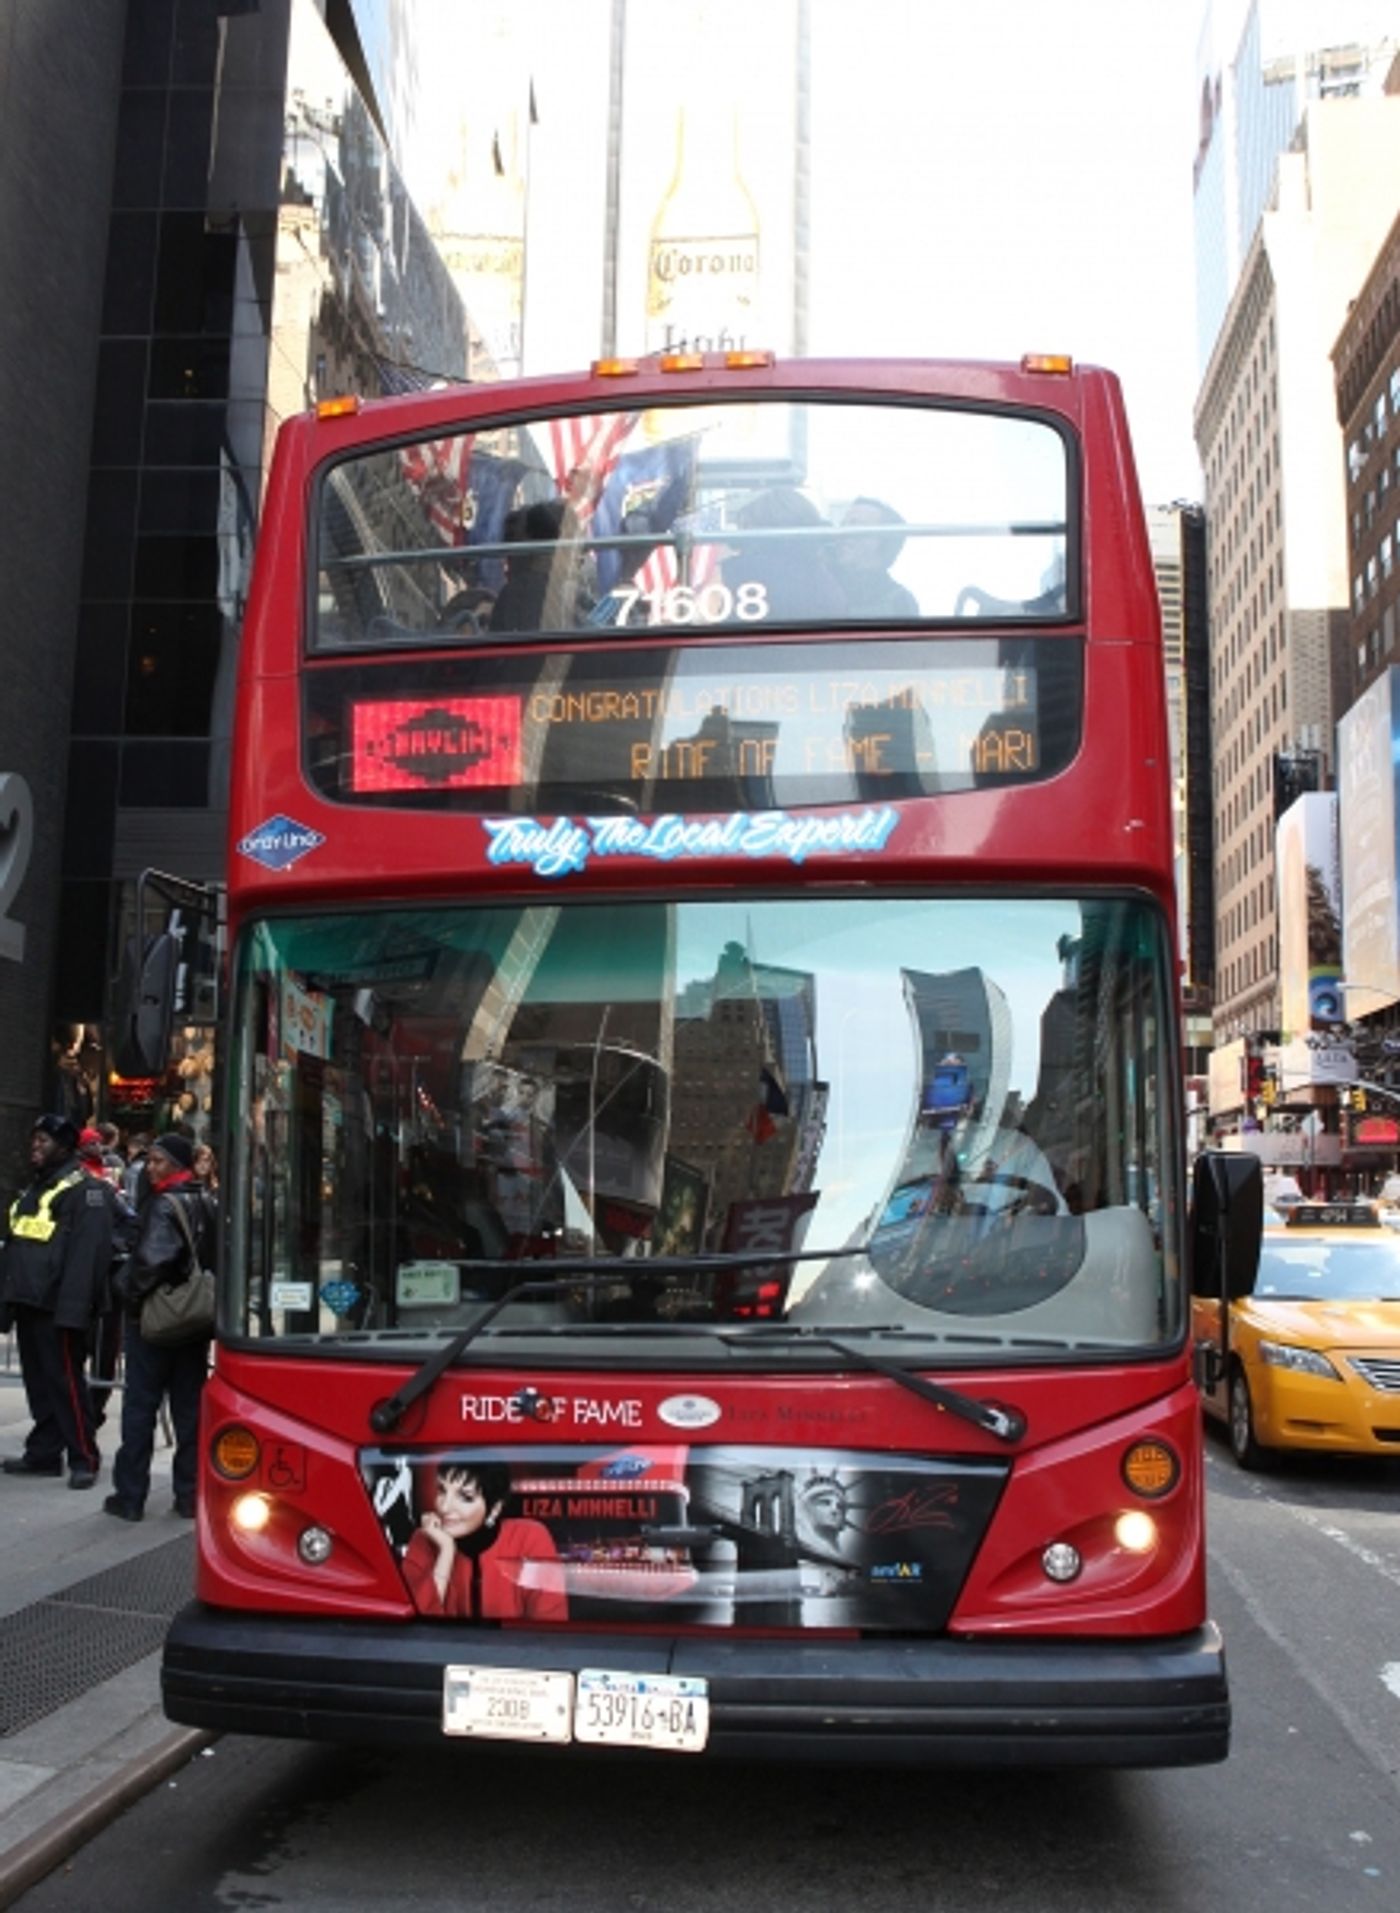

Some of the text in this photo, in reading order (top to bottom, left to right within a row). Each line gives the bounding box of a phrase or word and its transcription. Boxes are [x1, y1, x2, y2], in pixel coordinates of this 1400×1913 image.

[655, 248, 754, 282] Corona
[611, 582, 769, 627] 71608
[483, 806, 899, 876] Truly, The Local Expert!
[461, 1395, 523, 1423] RIDE
[573, 1397, 643, 1427] FAME
[522, 1498, 657, 1519] LIZA MINNELLI
